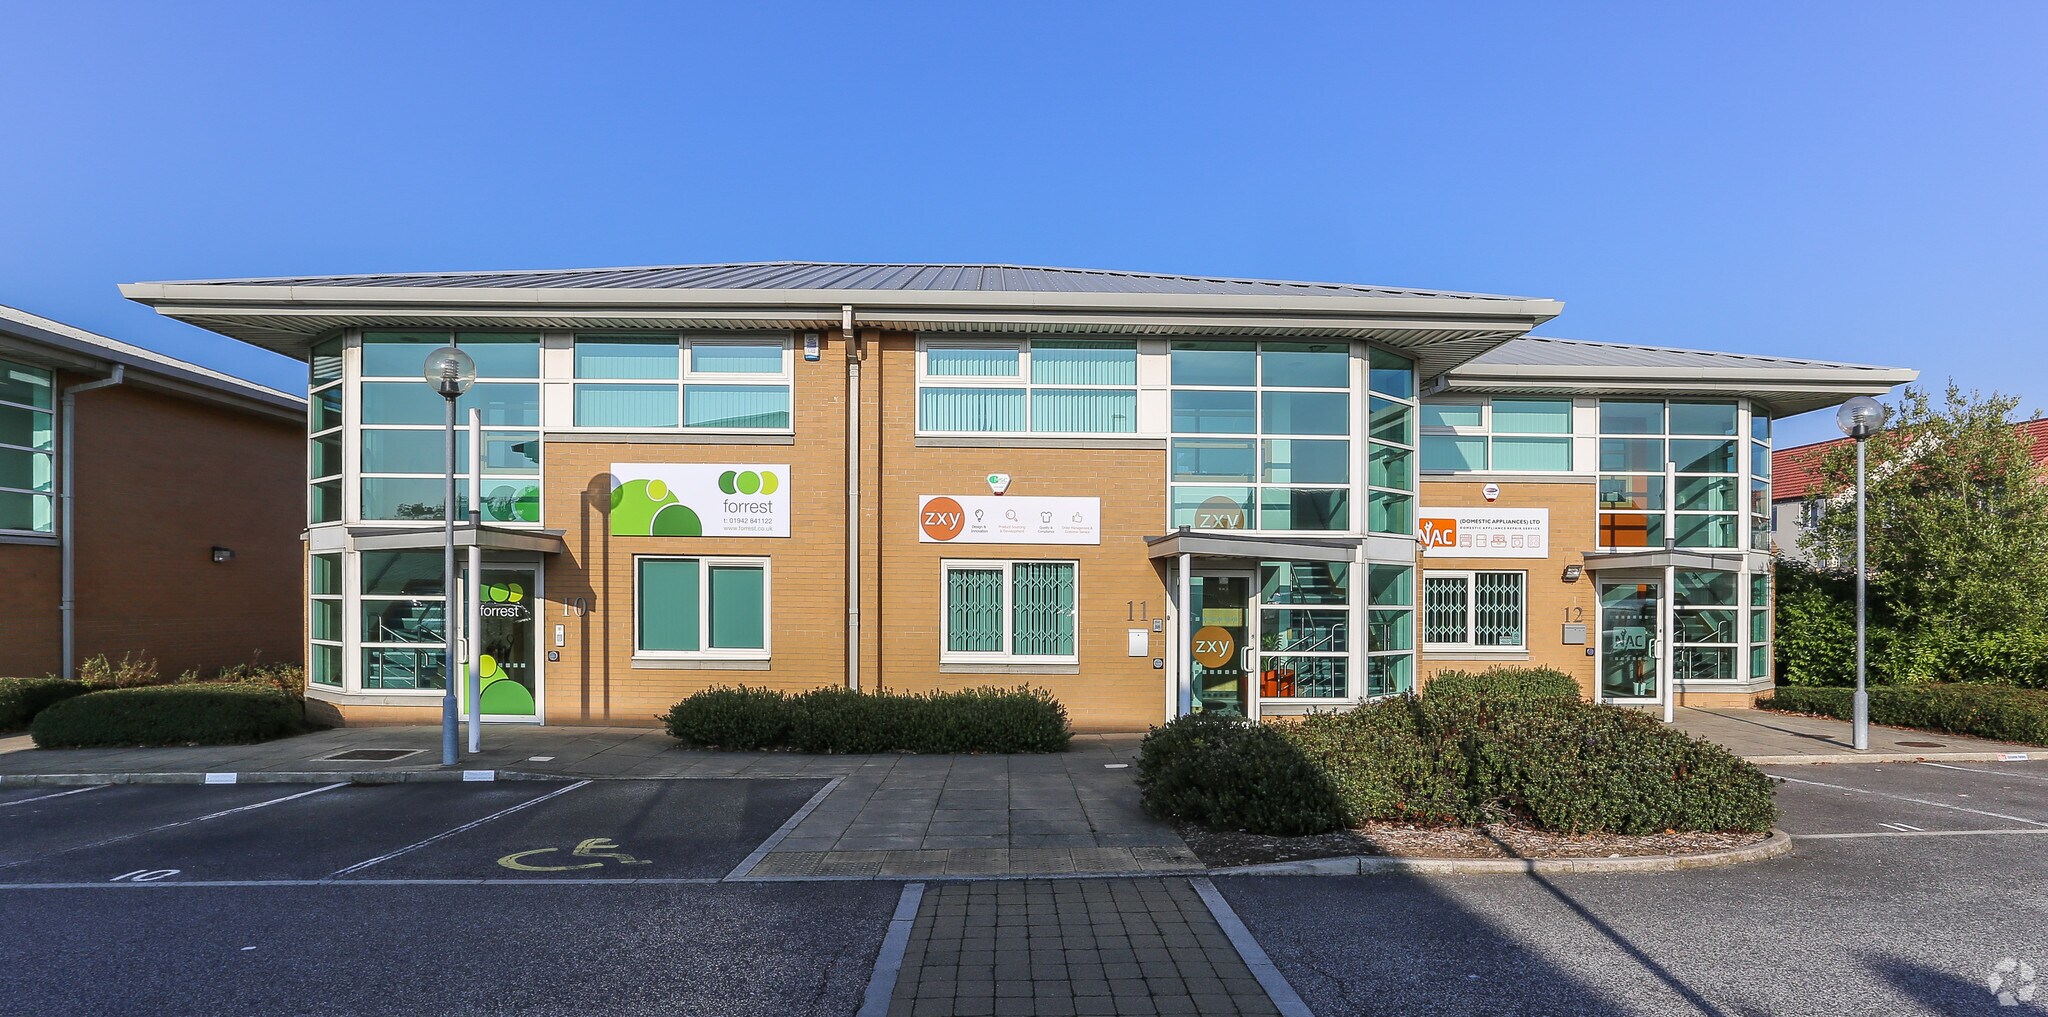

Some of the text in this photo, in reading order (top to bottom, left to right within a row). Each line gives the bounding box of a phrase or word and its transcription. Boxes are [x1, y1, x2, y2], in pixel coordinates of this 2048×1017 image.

[723, 499, 773, 513] forrest
[925, 512, 961, 531] zxy
[1200, 514, 1239, 529] zxy
[1419, 522, 1453, 548] NAC
[480, 604, 519, 617] forrest
[563, 597, 587, 617] 10
[1126, 600, 1148, 622] 11
[1563, 606, 1583, 623] 12
[1195, 640, 1229, 657] zxy
[1615, 631, 1643, 649] NAC
[109, 869, 181, 882] 10
